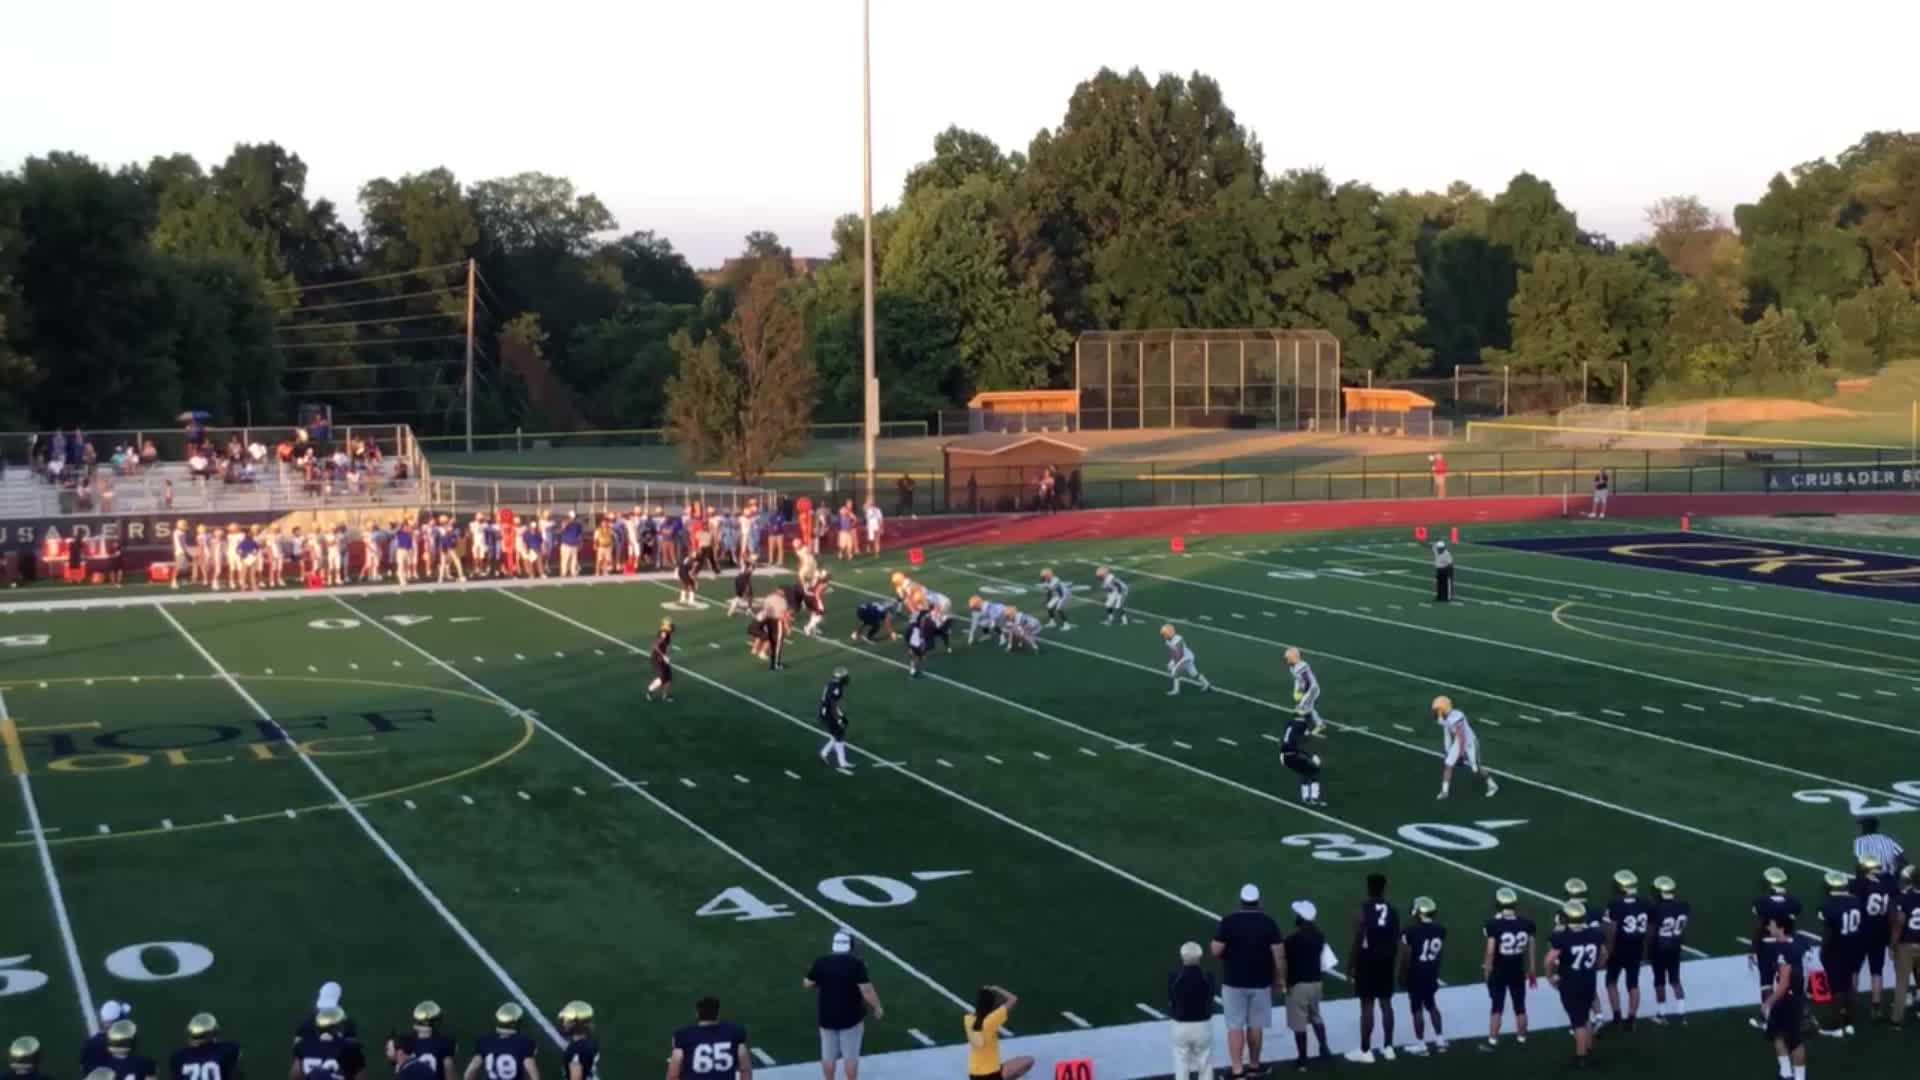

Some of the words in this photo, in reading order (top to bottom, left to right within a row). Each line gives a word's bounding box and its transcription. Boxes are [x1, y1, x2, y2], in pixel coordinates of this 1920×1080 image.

[1281, 822, 1499, 861] 30
[695, 875, 917, 921] 40
[1374, 903, 1388, 926] 7
[1623, 912, 1649, 934] 33
[1841, 909, 1861, 935] 10
[1419, 937, 1444, 963] 19
[1500, 932, 1530, 955] 22
[1571, 944, 1597, 970] 73
[693, 1042, 733, 1072] 65
